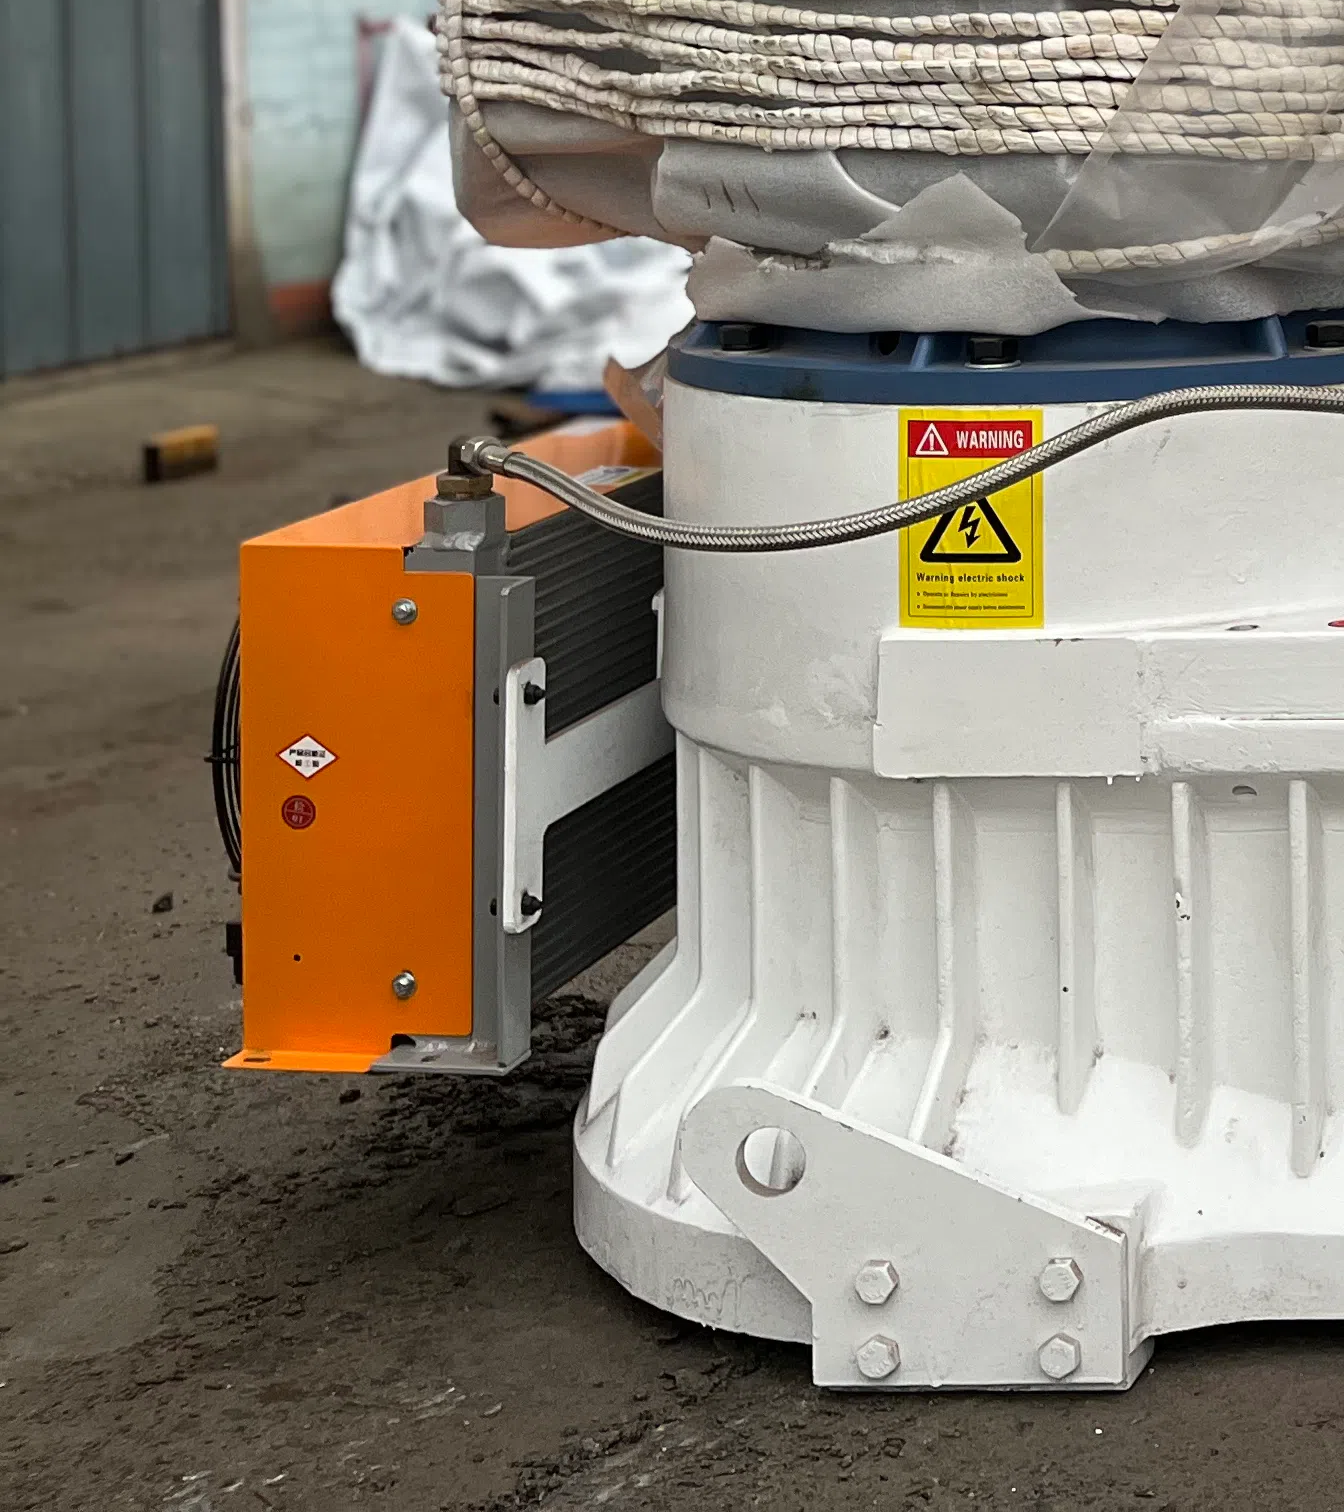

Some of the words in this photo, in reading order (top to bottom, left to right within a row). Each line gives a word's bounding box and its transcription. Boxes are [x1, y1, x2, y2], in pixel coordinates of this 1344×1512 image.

[956, 430, 1024, 449] WARNING
[916, 573, 954, 584] Warning
[958, 573, 993, 583] electric
[996, 573, 1025, 583] shock
